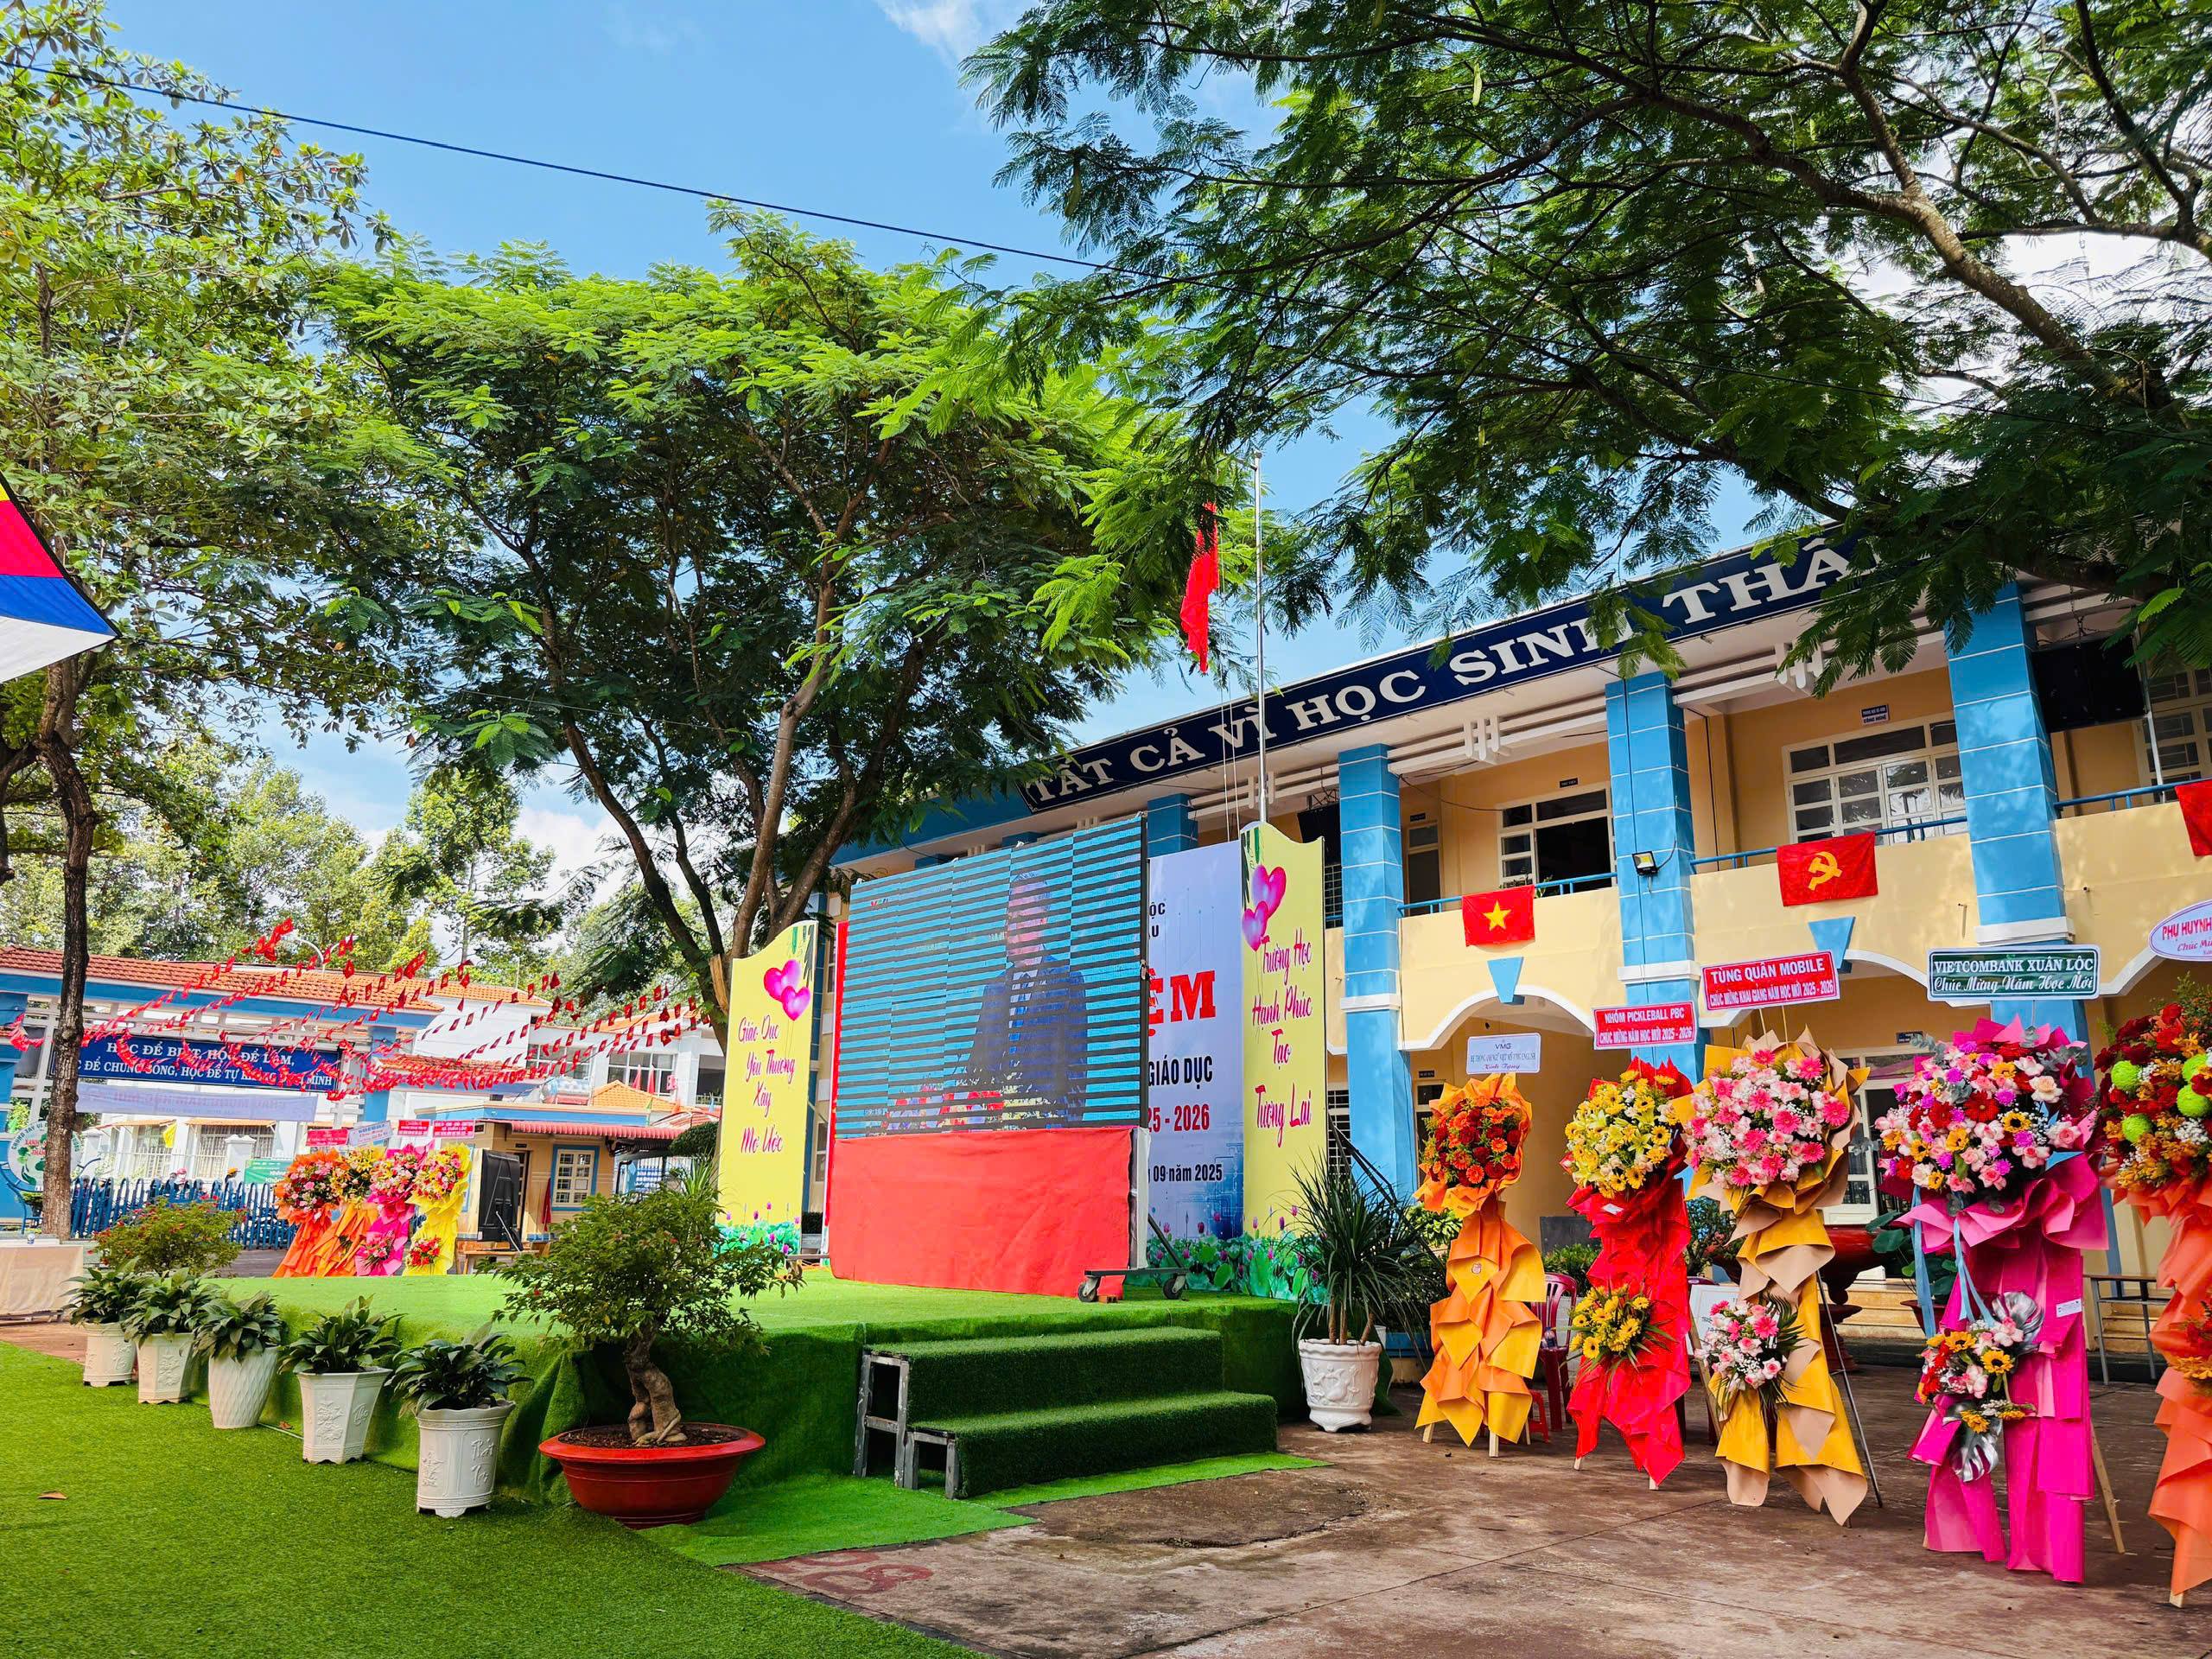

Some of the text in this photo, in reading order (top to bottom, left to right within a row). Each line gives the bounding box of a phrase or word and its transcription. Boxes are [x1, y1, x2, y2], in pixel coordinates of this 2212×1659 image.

[1130, 728, 1205, 772] CẢ
[1208, 706, 1277, 748] VÌ
[1285, 670, 1426, 731] HỌC
[1662, 537, 1882, 625] THÂ
[2163, 917, 2212, 941] PHỤ HUYNH
[1262, 927, 1312, 985] Trường Học
[1934, 956, 2094, 976] VIETCOMBANK XUÂN LỘC
[1711, 958, 1825, 984] TÙNG QUÂN MOBILE
[1935, 974, 2094, 993] Chúc Mừng Năm Học Mới
[1252, 985, 1313, 1030] Hạnh Phúc
[1605, 1007, 1684, 1023] NHÓM PICKLEBALL PBC
[739, 1014, 779, 1044] Giáo Dục
[1662, 1028, 1675, 1040] 2025
[1679, 1027, 1692, 1039] 2026
[106, 1043, 138, 1054] HC
[143, 1041, 162, 1055] ĐỂ
[241, 1048, 259, 1062] ĐỂ
[263, 1052, 294, 1065] LM,
[1272, 1028, 1291, 1070] Tạo
[85, 1056, 100, 1071] ĐỂ
[181, 1067, 204, 1080] HỌC
[225, 1069, 239, 1082] TỰ
[1148, 1055, 1212, 1089] GIÁO DỤC
[753, 1081, 772, 1117] Xây
[1289, 1082, 1312, 1127] Lai
[1174, 1103, 1210, 1132] 2026
[1154, 1164, 1222, 1182] 09 năm 2025
